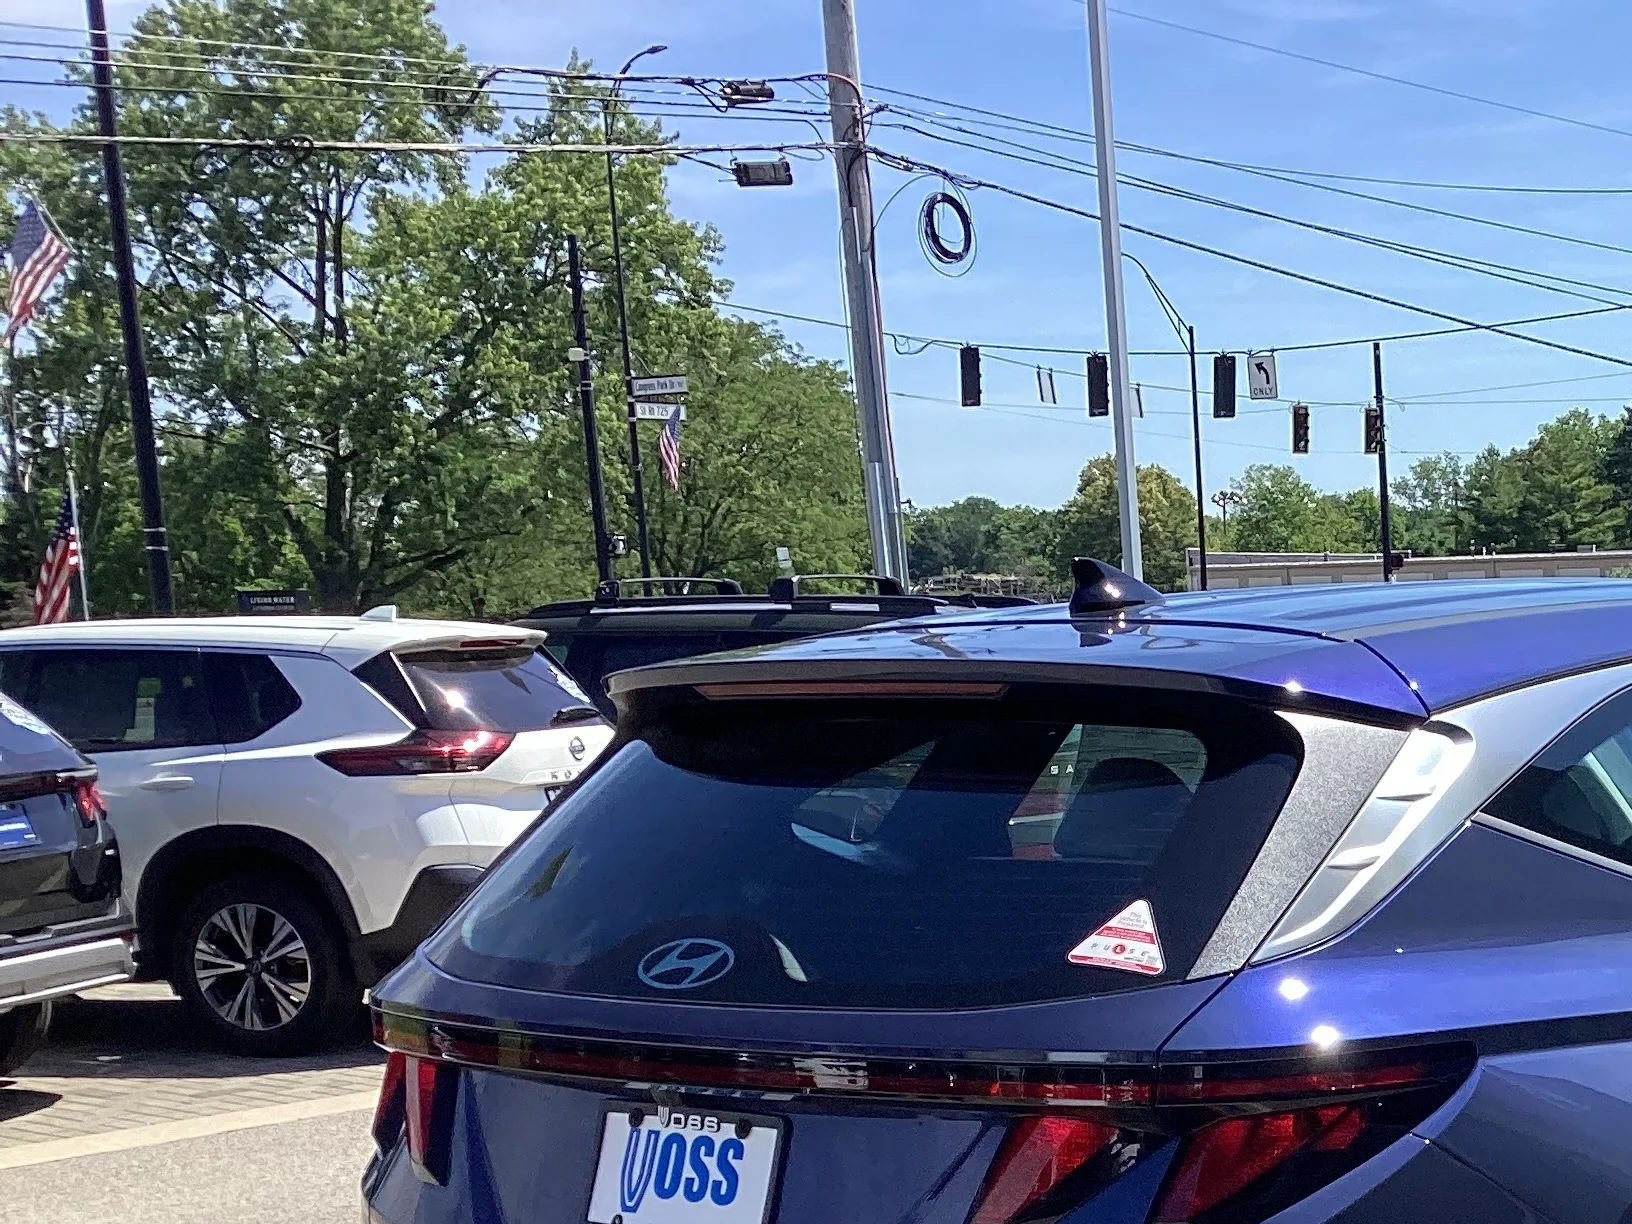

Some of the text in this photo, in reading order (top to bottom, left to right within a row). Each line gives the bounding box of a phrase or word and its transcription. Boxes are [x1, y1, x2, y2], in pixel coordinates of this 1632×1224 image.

[1253, 387, 1273, 397] ONLY
[657, 1105, 720, 1132] VOSS
[620, 1127, 745, 1214] VOSS
